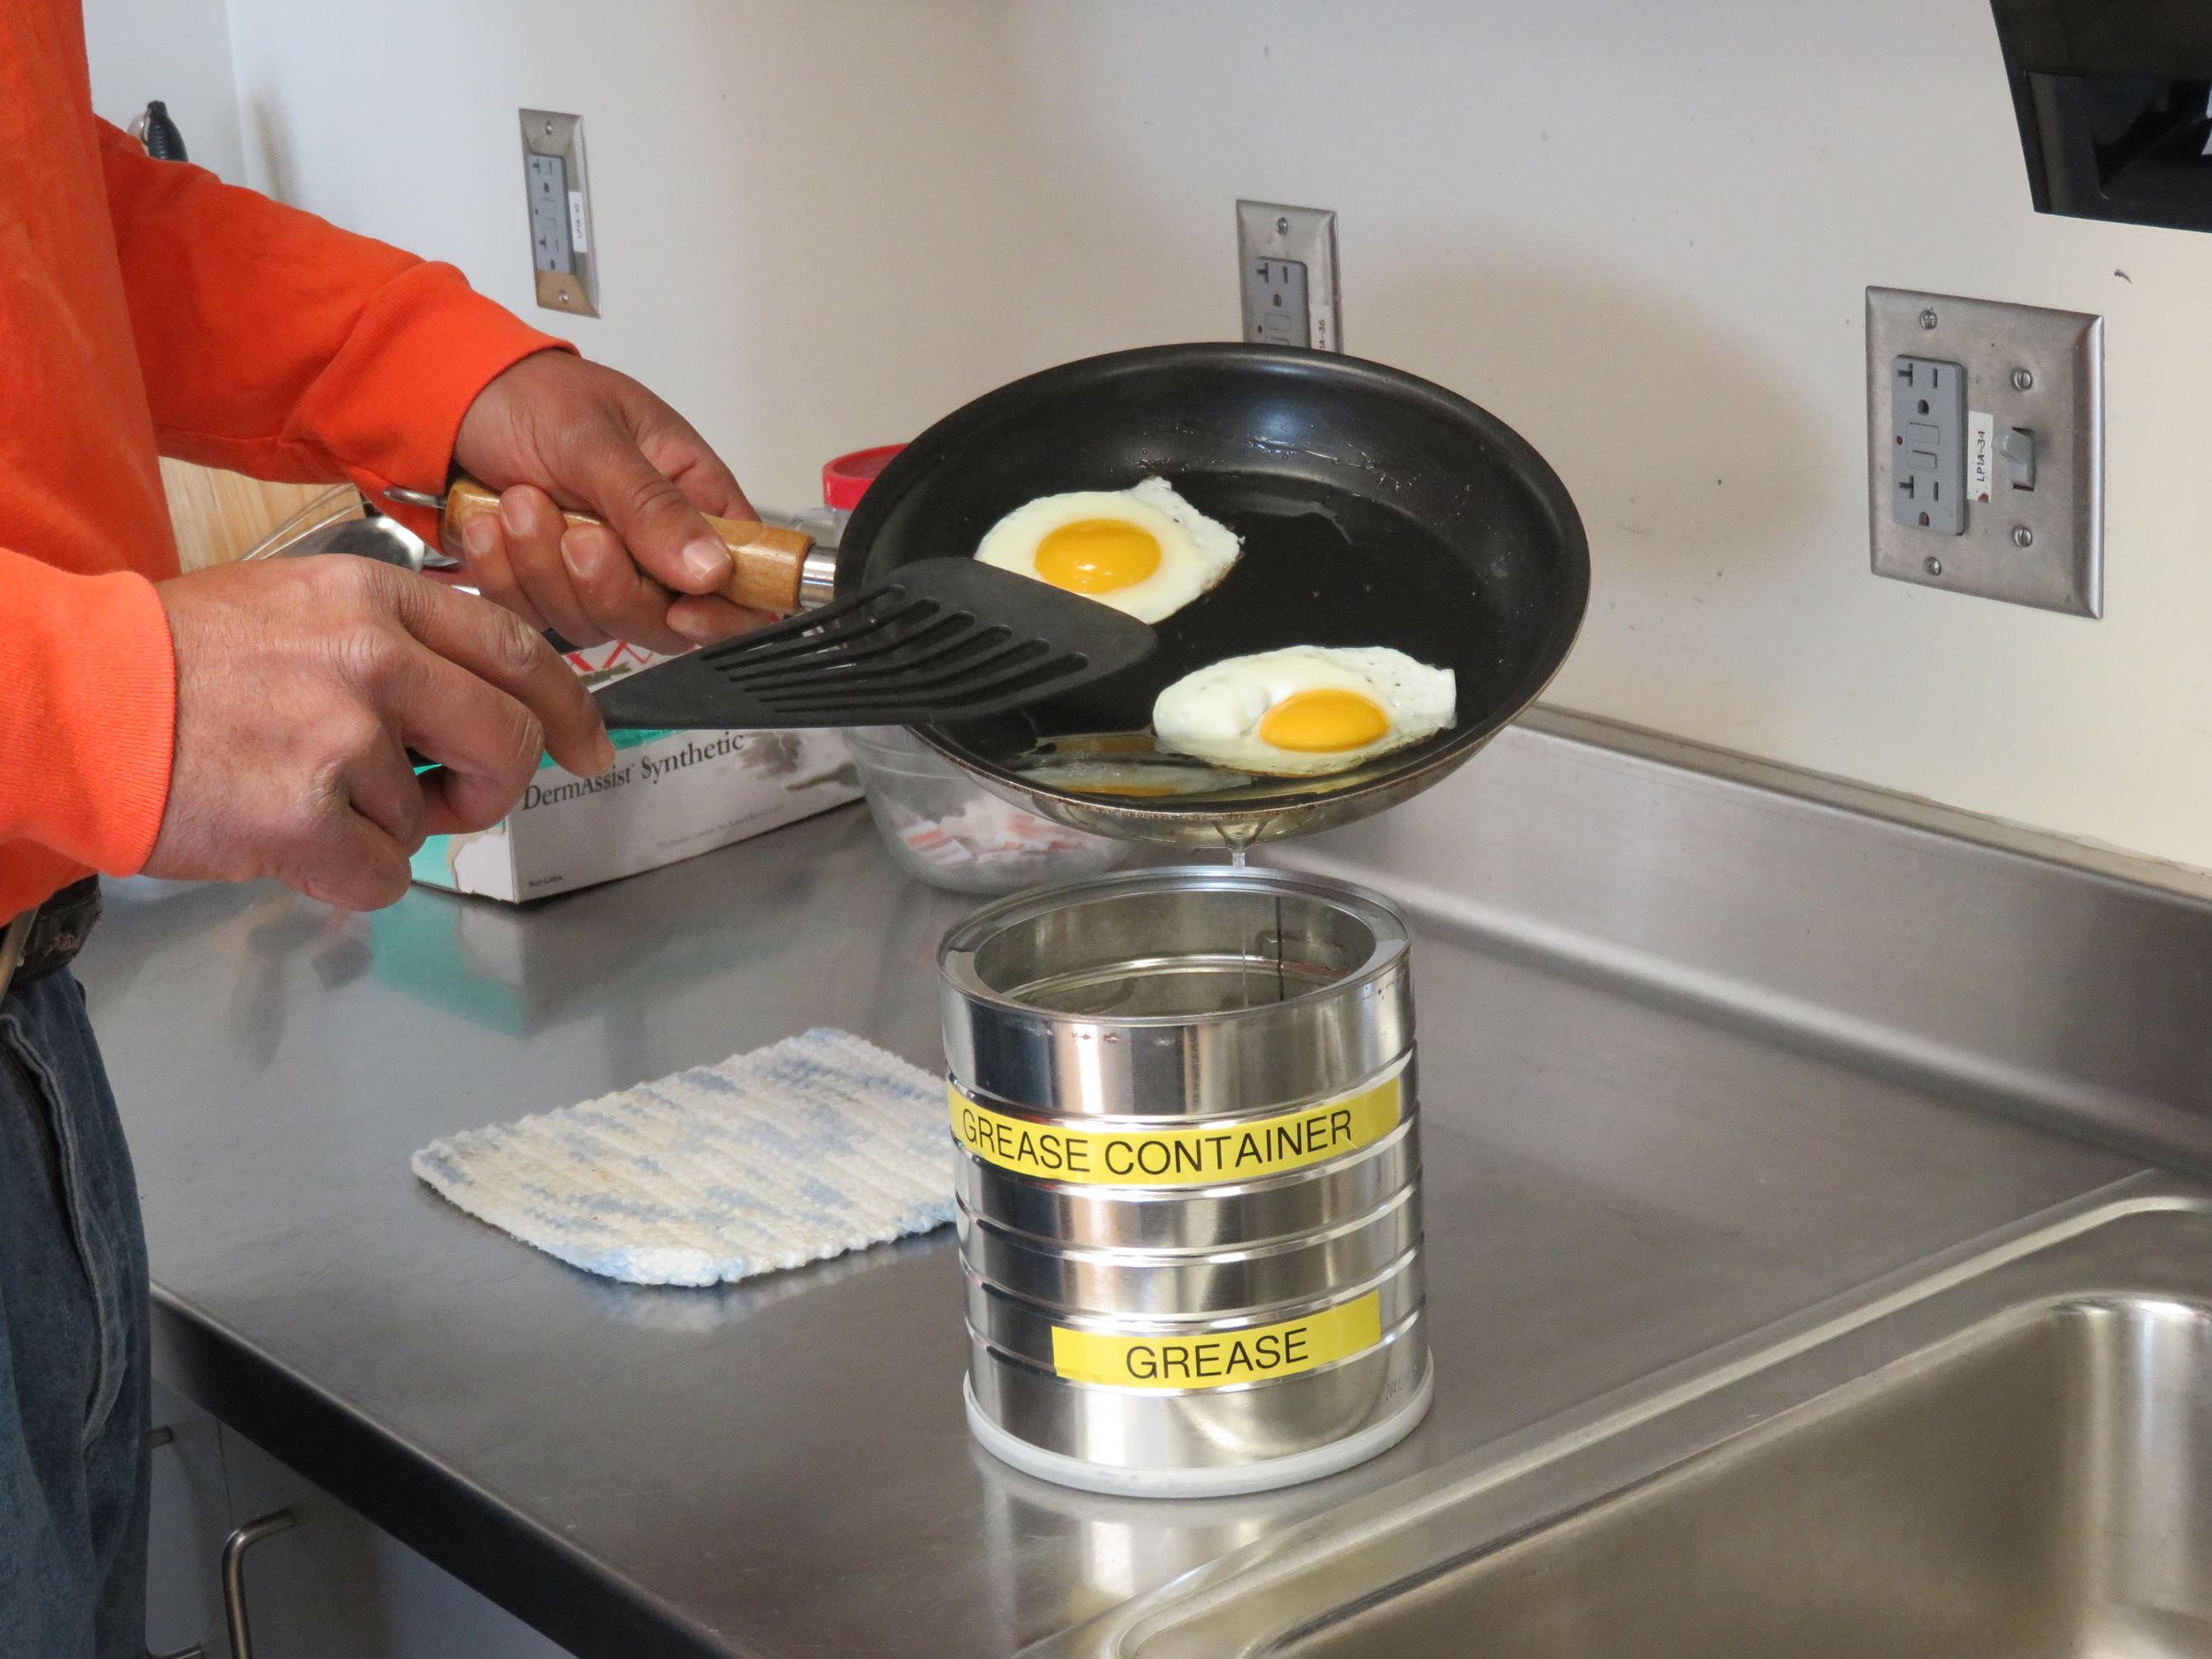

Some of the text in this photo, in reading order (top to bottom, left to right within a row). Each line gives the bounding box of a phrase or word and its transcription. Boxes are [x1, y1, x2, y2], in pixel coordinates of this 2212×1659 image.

[1976, 430, 1986, 482] LP1A-34
[522, 730, 744, 812] DermAssist Synthetic
[962, 1108, 1353, 1176] GREASE CONTAINER
[1126, 1327, 1309, 1380] GREASE
